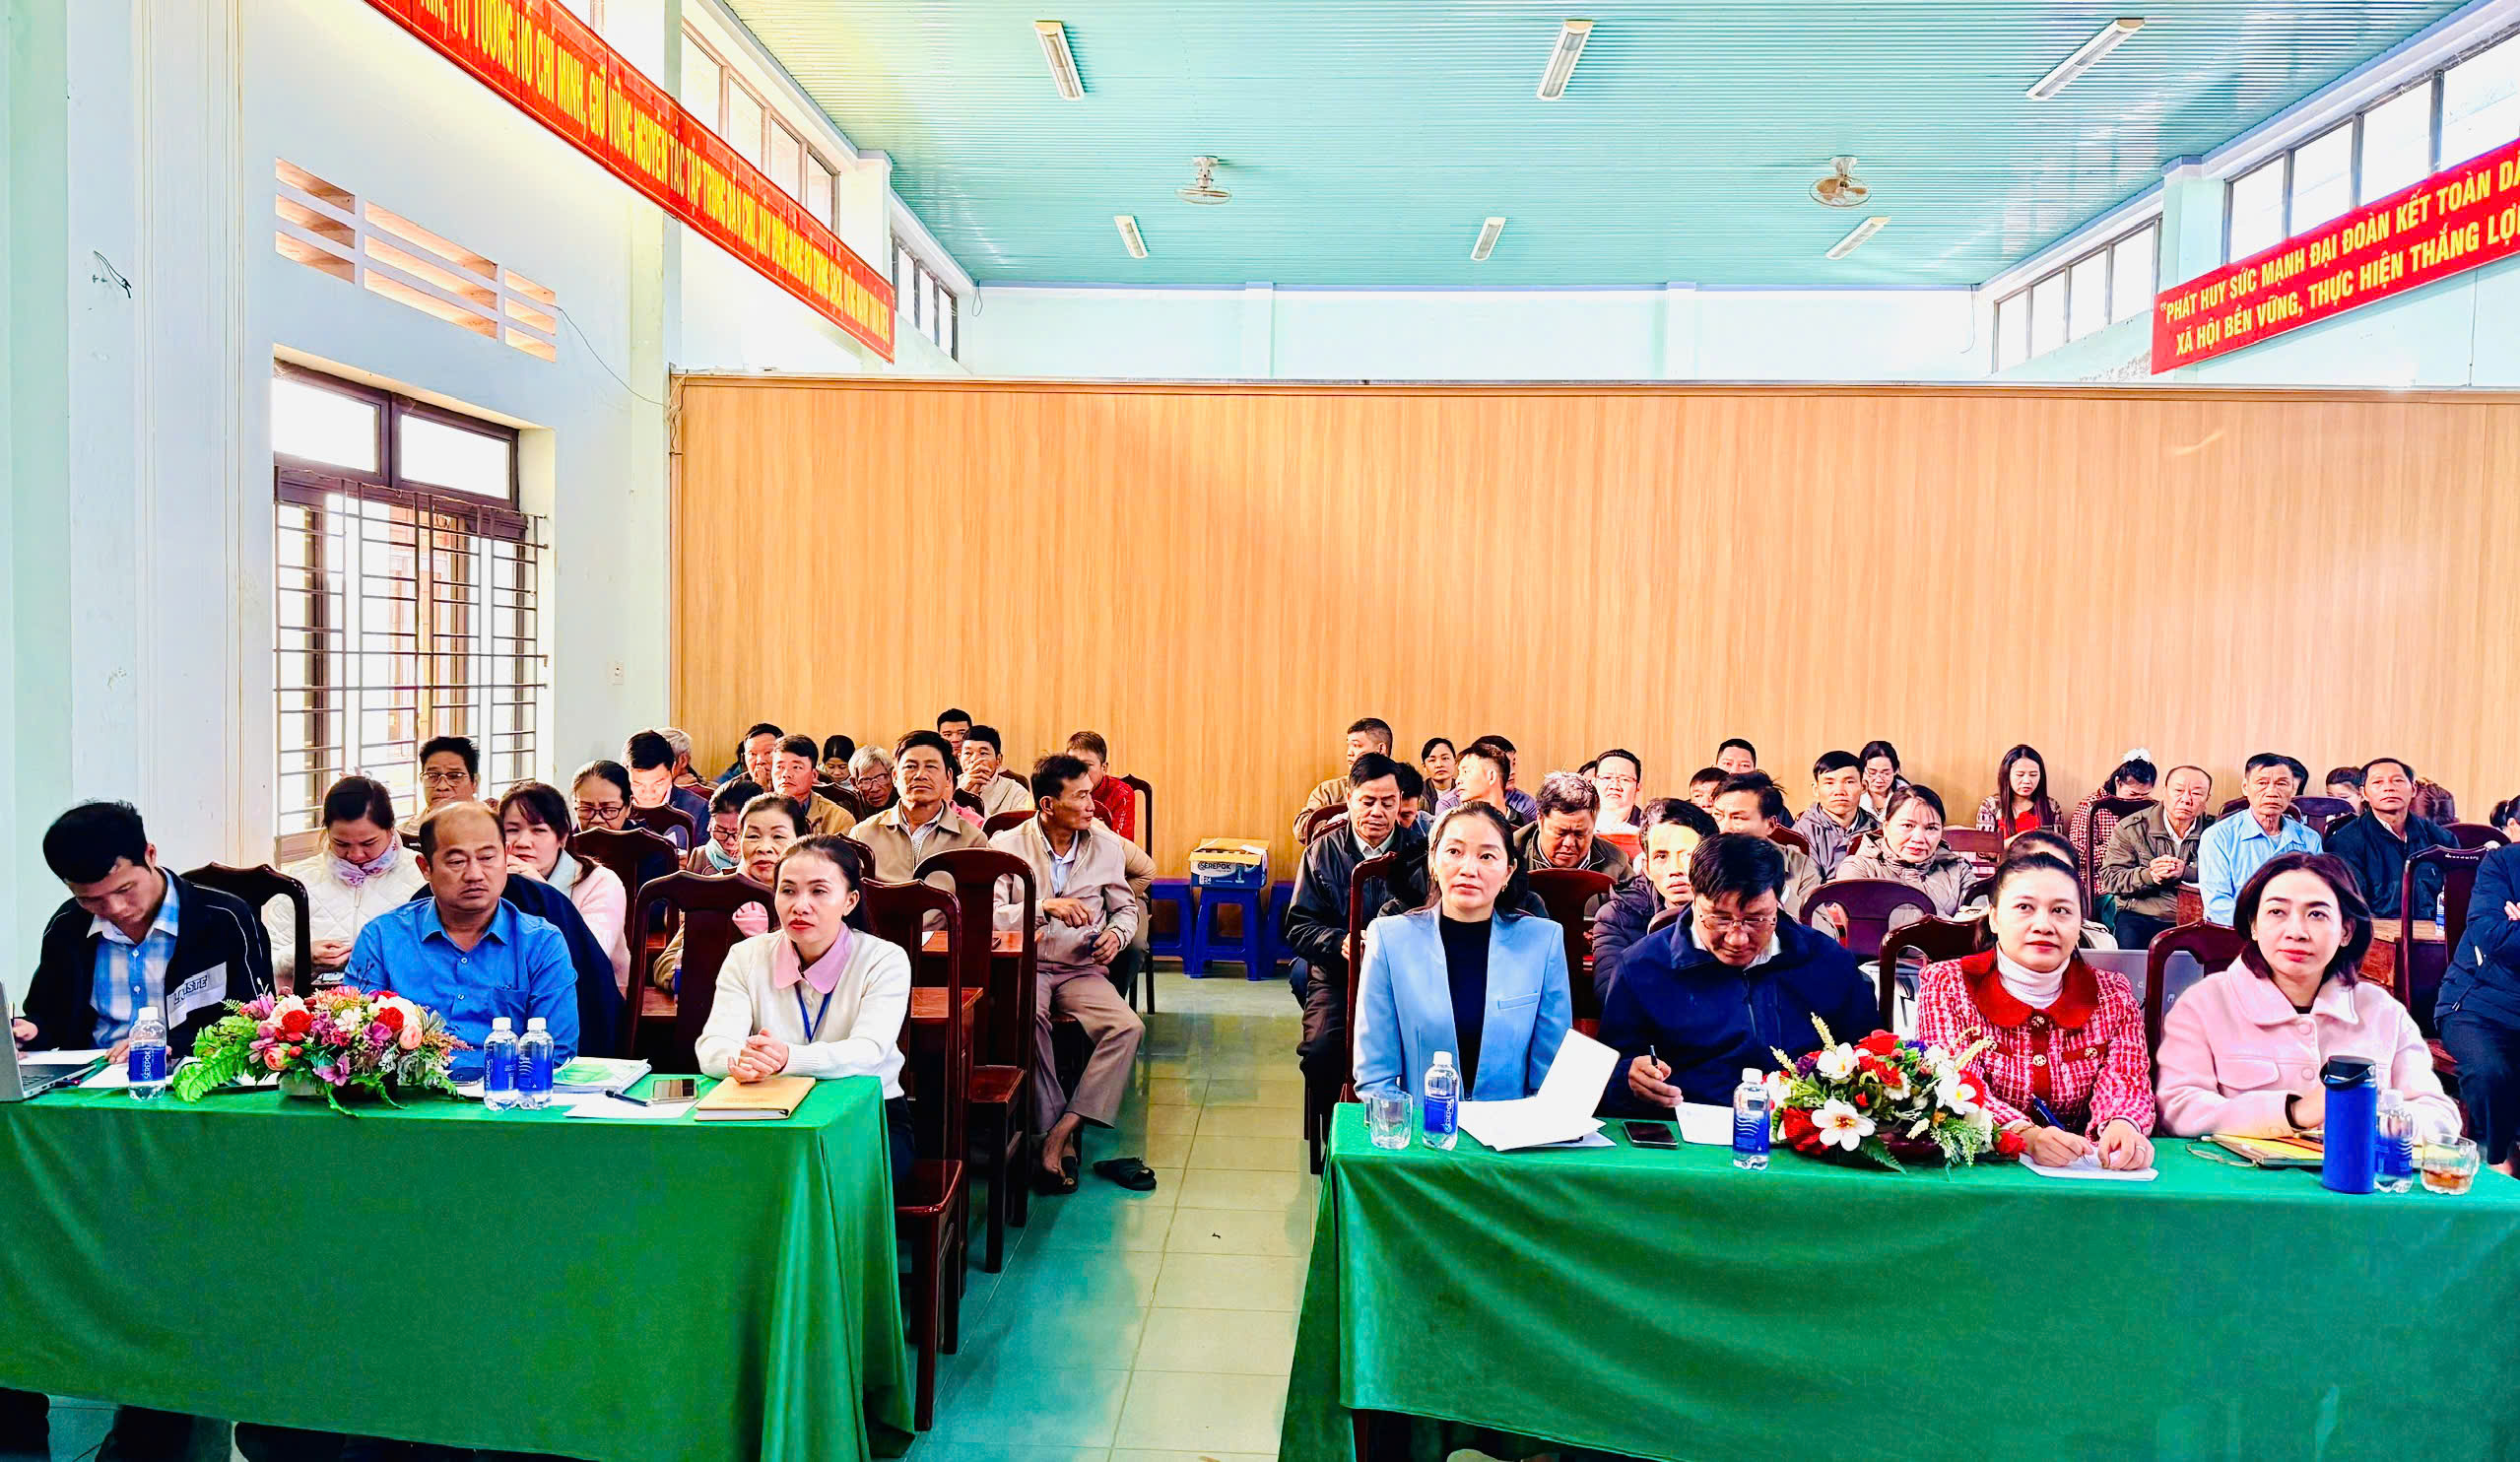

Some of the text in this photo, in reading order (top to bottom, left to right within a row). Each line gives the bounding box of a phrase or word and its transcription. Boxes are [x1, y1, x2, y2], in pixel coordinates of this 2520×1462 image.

[558, 44, 587, 140] MINH,
[2175, 325, 2193, 356] XÃ
[2196, 316, 2221, 351] HỘI
[2224, 303, 2252, 339] BỀN
[2256, 292, 2303, 327] VỮNG,
[2307, 270, 2354, 309] THỰC
[2359, 249, 2404, 291] HIỆN
[2410, 222, 2480, 273] THẮNG
[2200, 280, 2226, 311] HUY
[2229, 267, 2257, 299] SỨC
[2261, 247, 2305, 287] MẠNH
[2309, 233, 2337, 268] ĐẠI
[2342, 212, 2390, 255] ĐOÀN
[2396, 187, 2431, 233] KẾT
[2436, 168, 2491, 216] TOÀN
